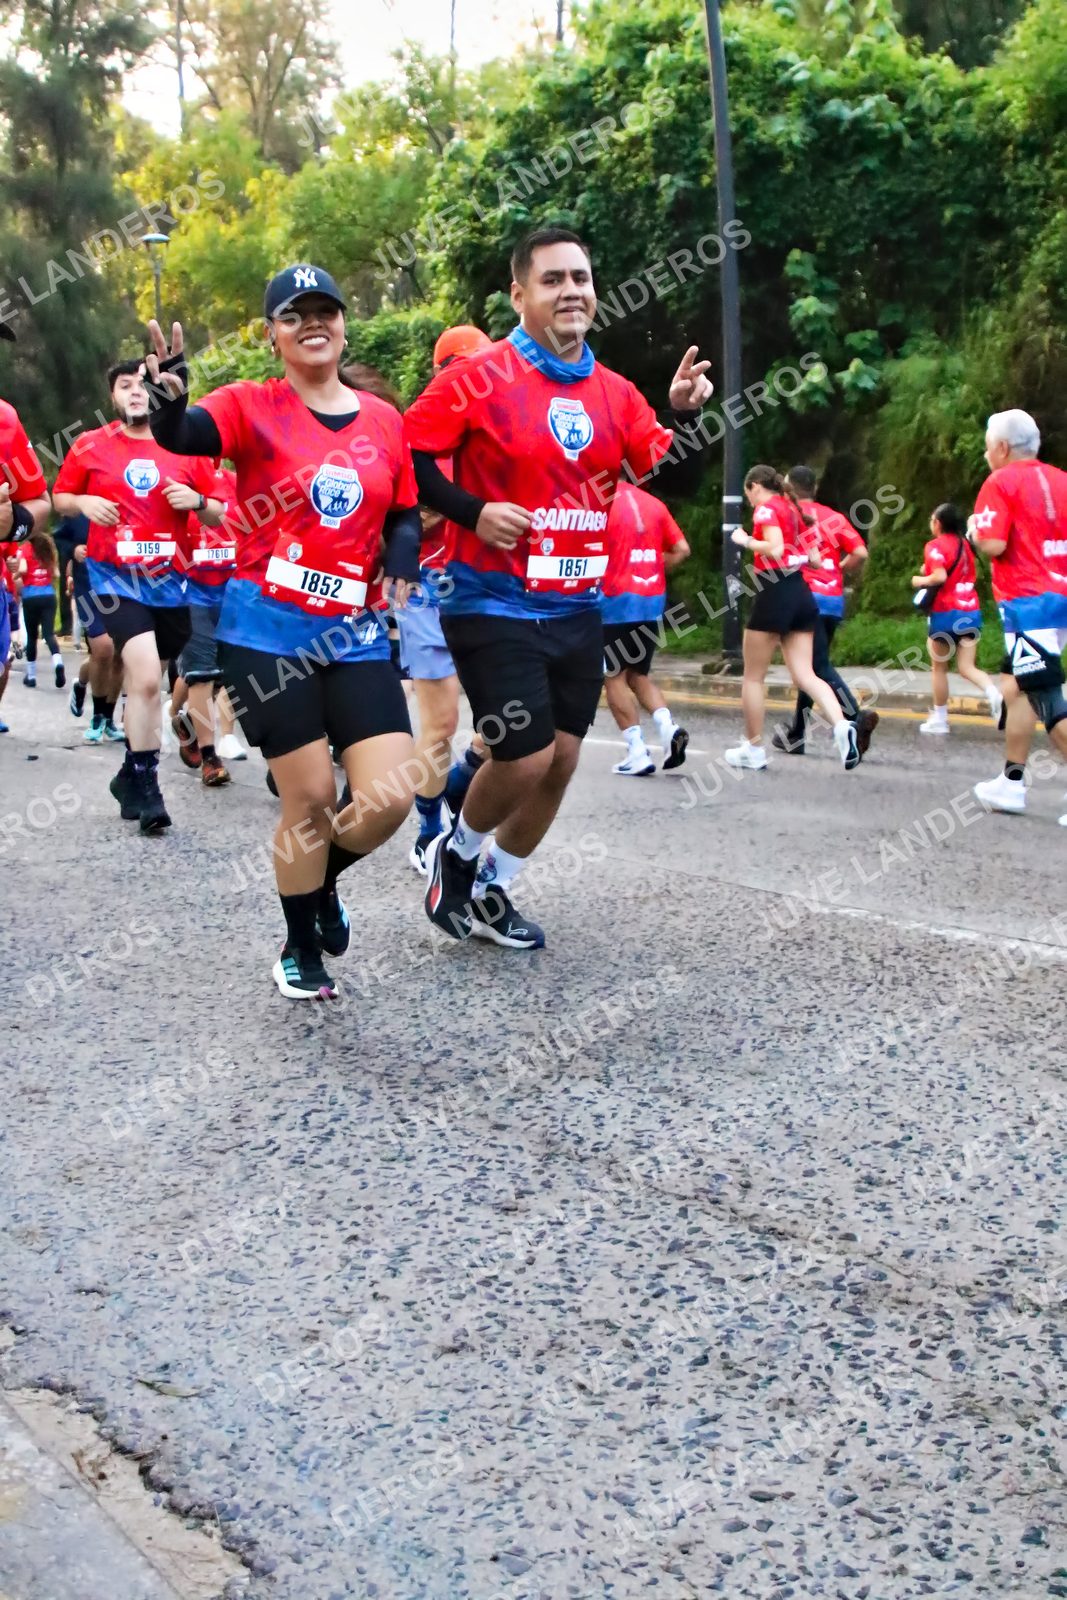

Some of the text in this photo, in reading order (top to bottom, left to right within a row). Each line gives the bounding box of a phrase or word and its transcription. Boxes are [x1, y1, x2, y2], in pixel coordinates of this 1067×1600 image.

[136, 542, 161, 555] 3159
[558, 557, 588, 577] 1851
[300, 570, 343, 599] 1852
